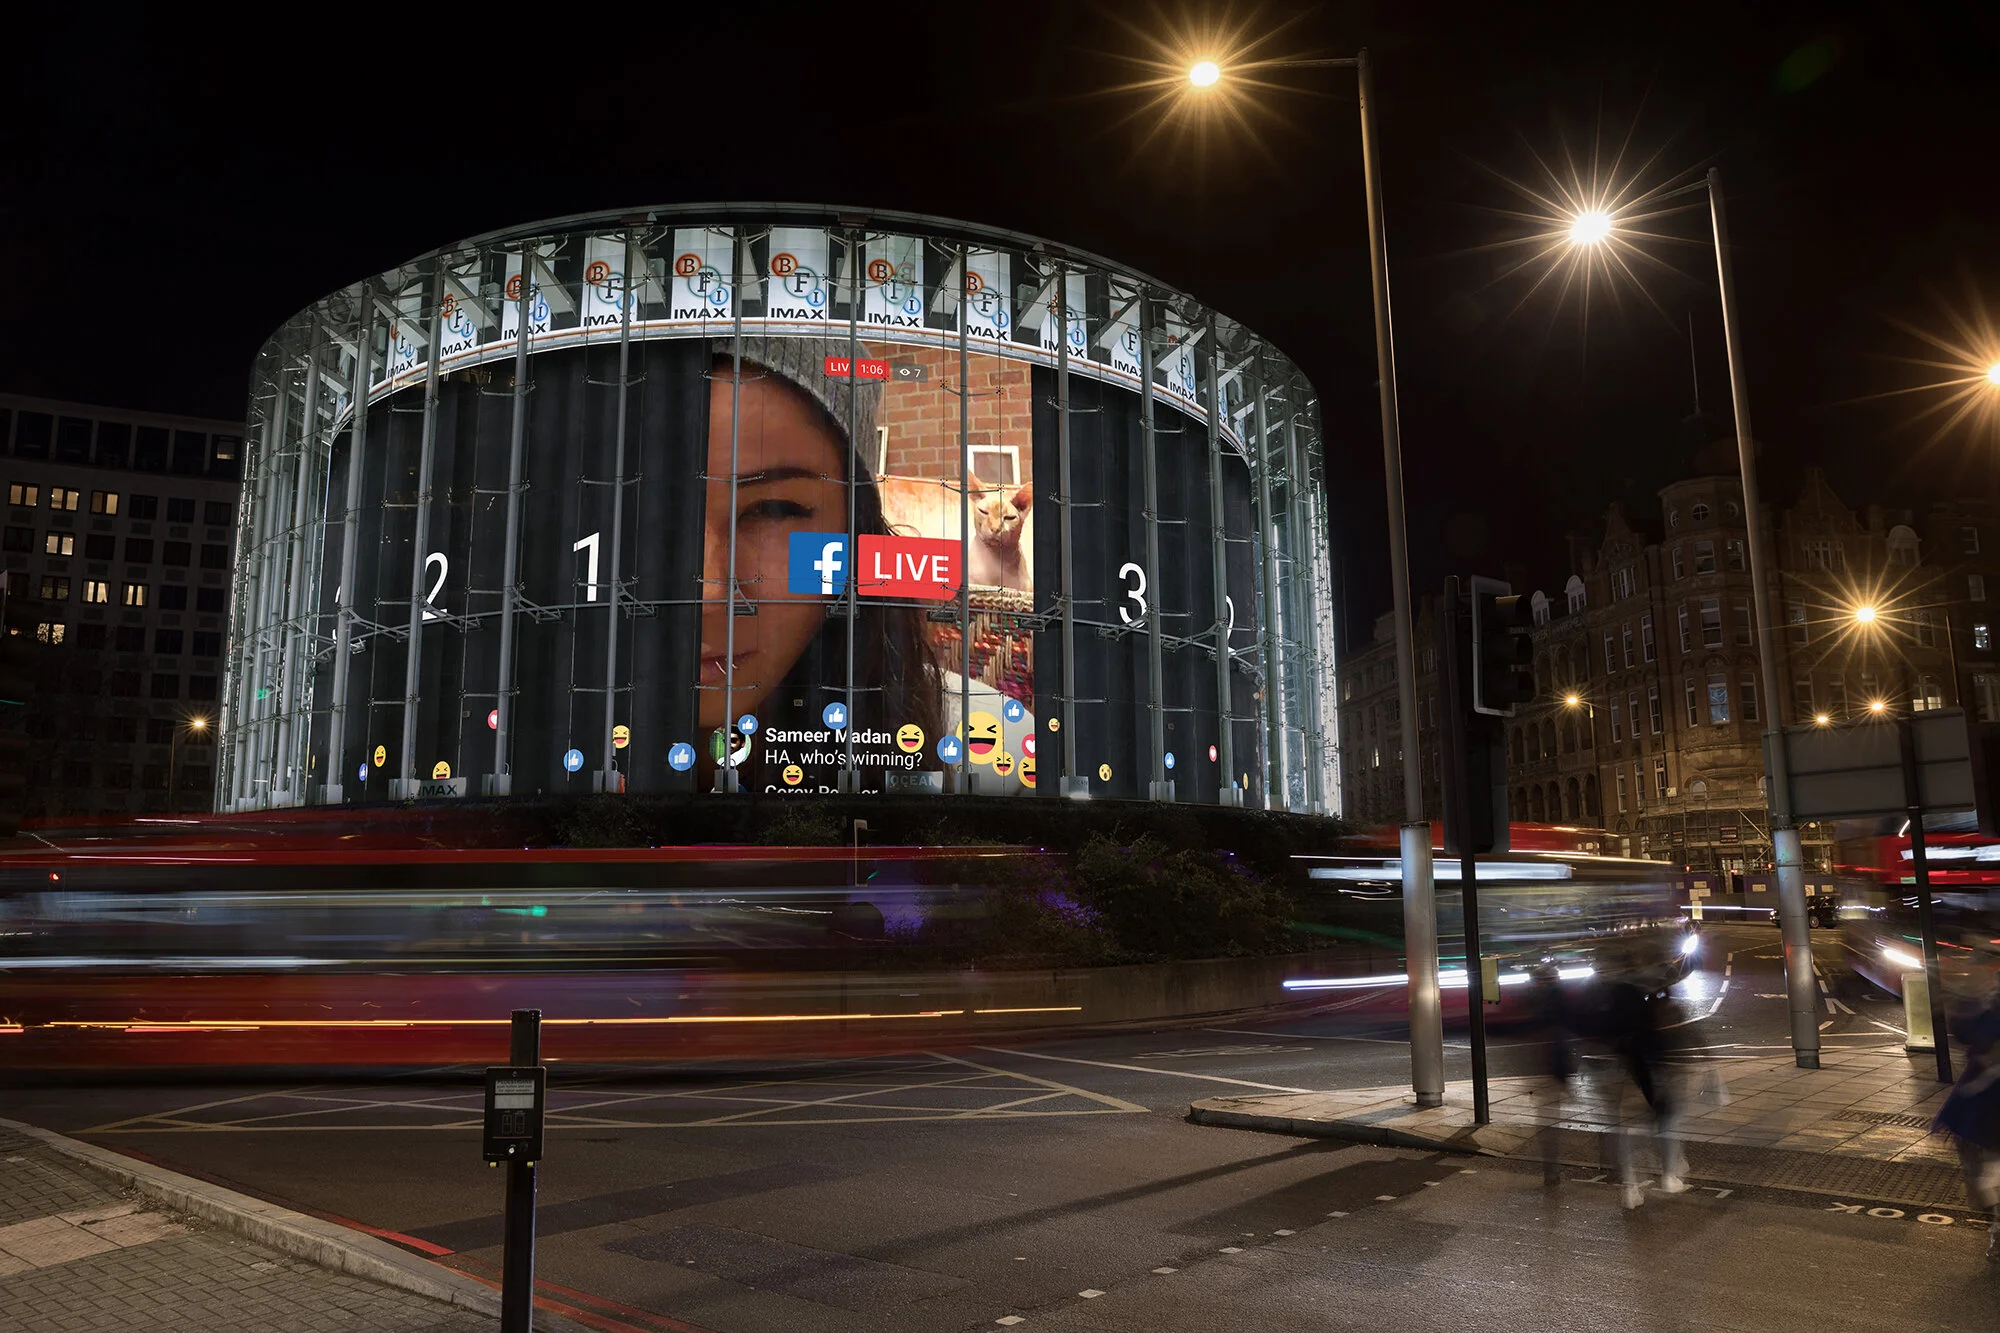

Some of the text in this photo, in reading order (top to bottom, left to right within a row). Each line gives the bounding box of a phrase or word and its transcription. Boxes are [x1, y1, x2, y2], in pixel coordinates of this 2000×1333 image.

[674, 307, 728, 320] IMAX
[770, 307, 825, 320] IMAX
[868, 312, 921, 329] IMAX
[966, 325, 1009, 342] MAX
[441, 338, 474, 357] MAX
[387, 358, 414, 379] IMAX
[830, 361, 884, 376] LIV 1:06
[914, 368, 922, 379] 7
[1113, 359, 1143, 378] IMA
[1169, 380, 1196, 403] IMAX
[573, 532, 600, 602] 1
[873, 551, 950, 583] LIVE
[422, 551, 449, 621] 2
[1118, 562, 1147, 629] 3
[764, 727, 892, 745] Sameer Madan
[765, 749, 923, 771] HA. who's winning?
[890, 775, 939, 787] OCEAN
